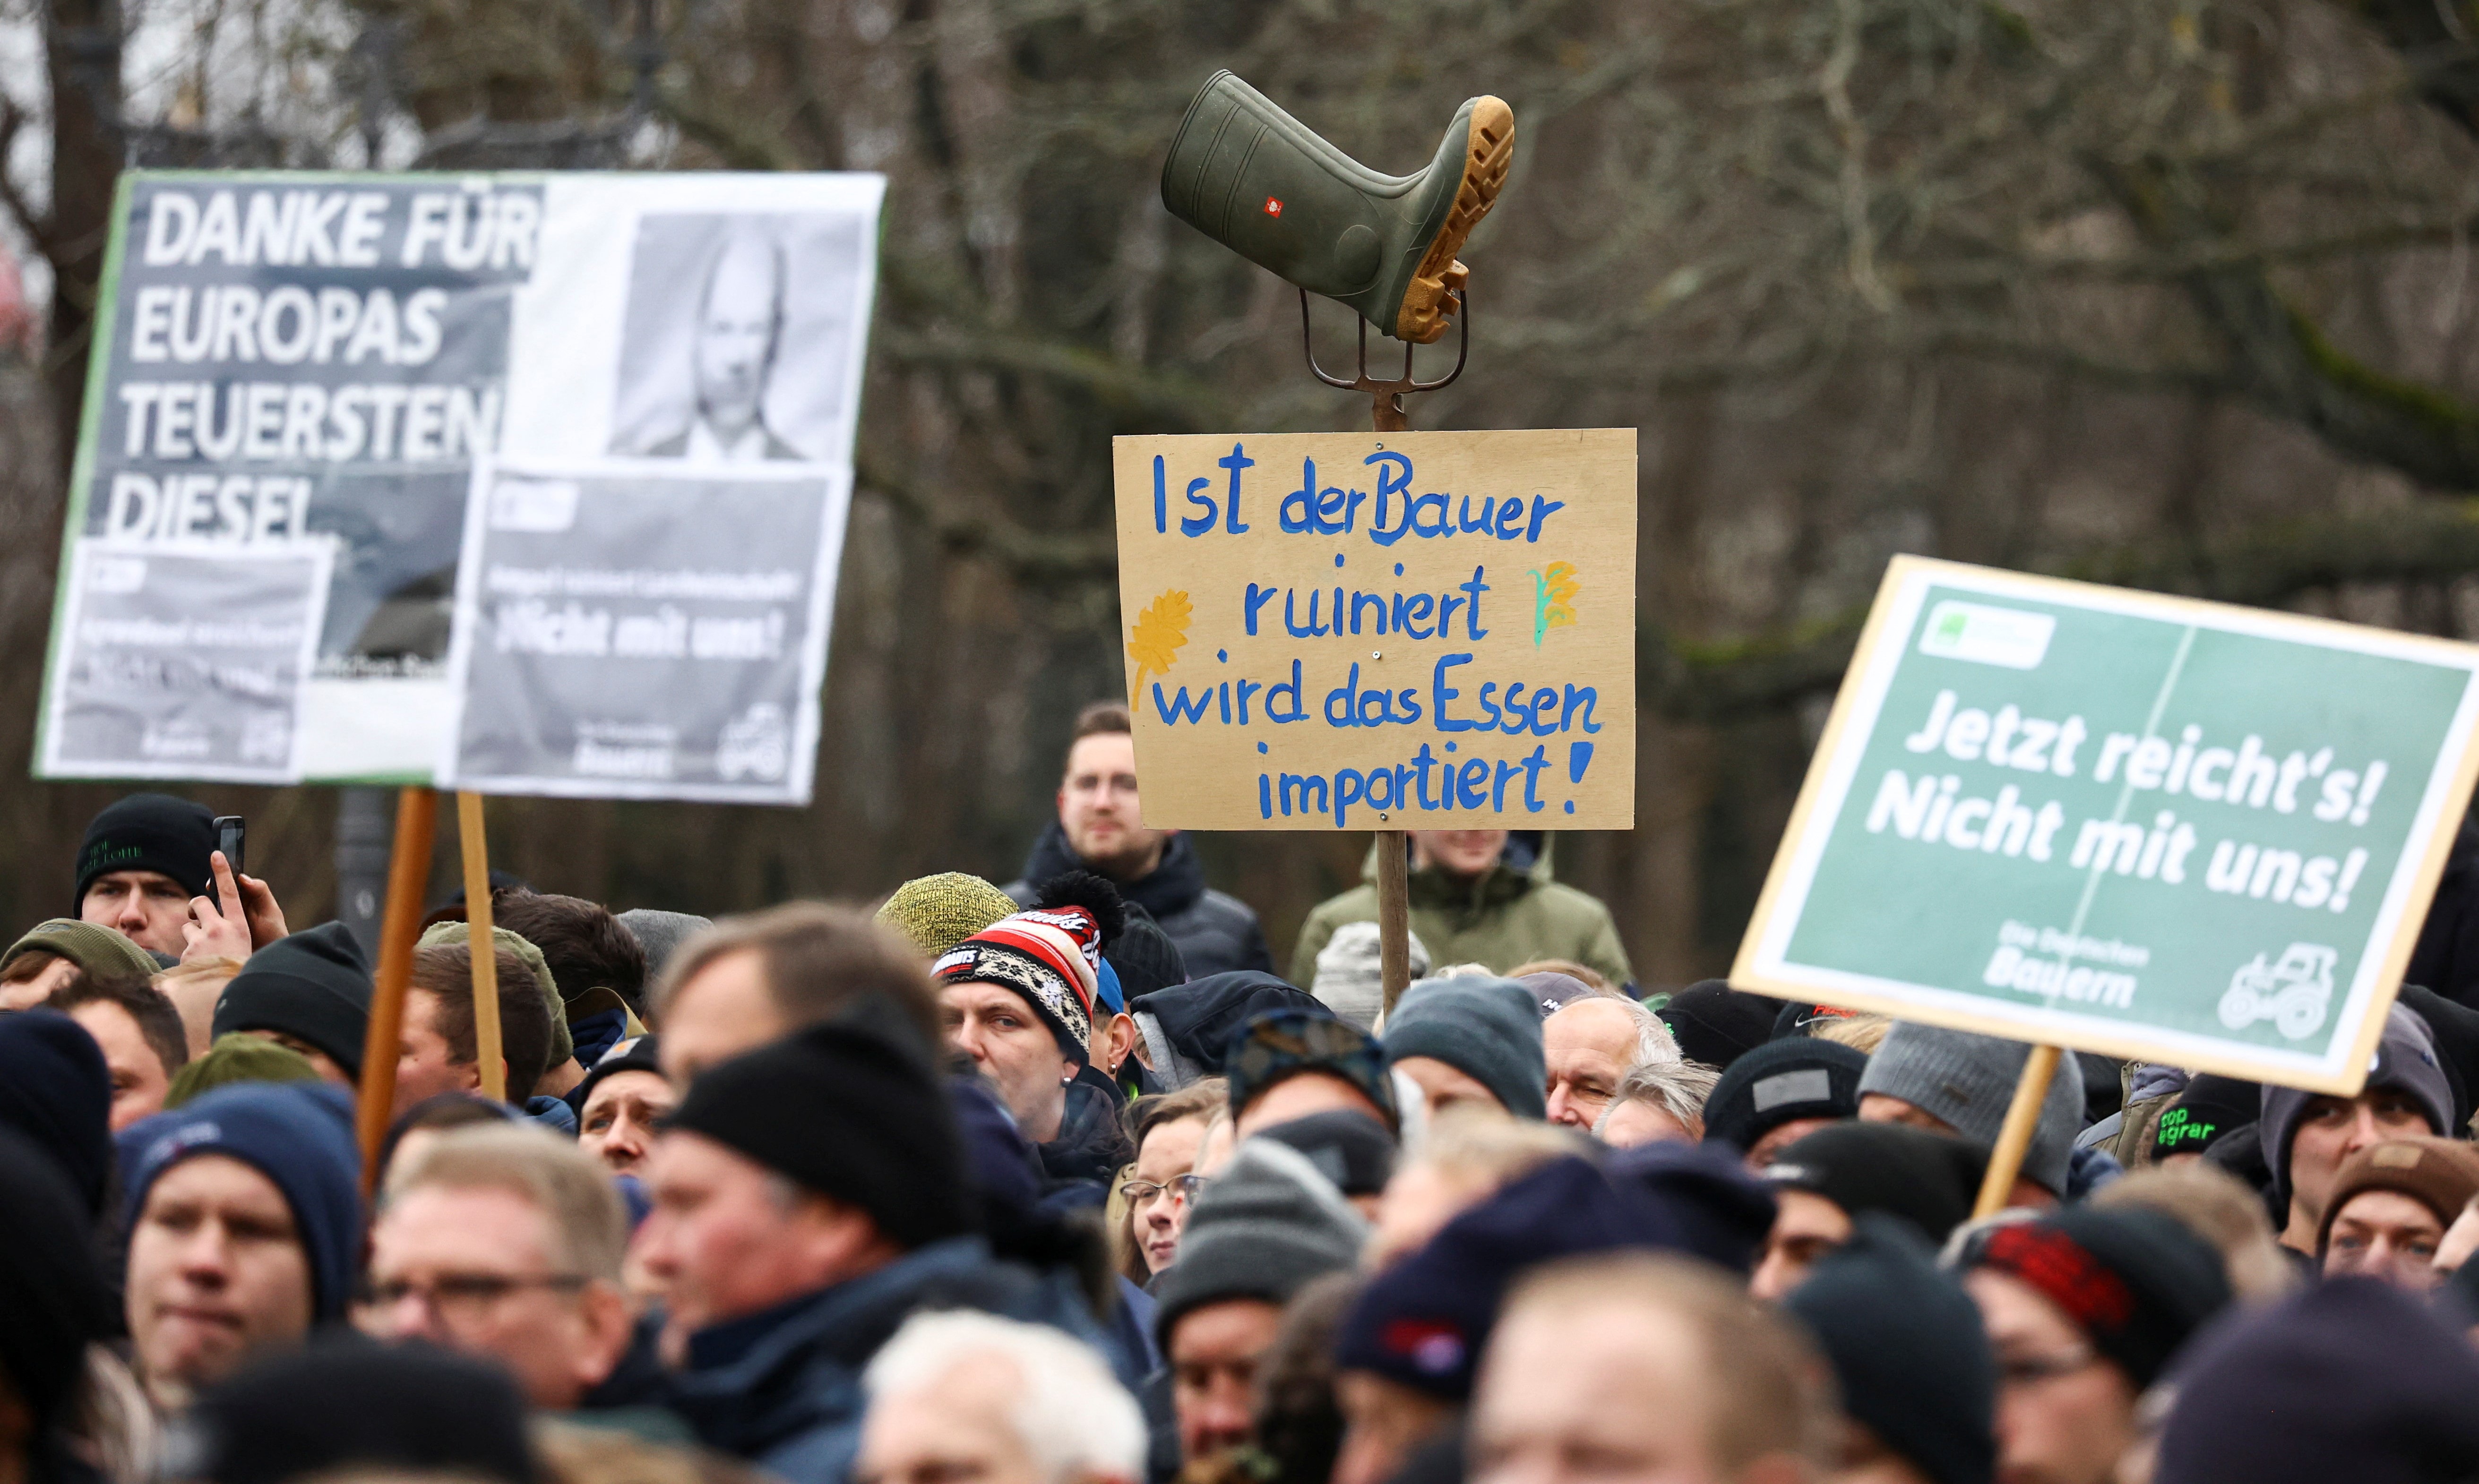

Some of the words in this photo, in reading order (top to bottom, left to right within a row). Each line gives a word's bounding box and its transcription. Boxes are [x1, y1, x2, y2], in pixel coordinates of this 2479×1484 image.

[144, 190, 390, 266] DANKE
[401, 179, 539, 269] FÜR
[129, 285, 448, 365] EUROPAS
[119, 383, 499, 461] TEUERSTEN
[106, 472, 319, 540] DIESEL
[1153, 443, 1255, 538] Ist
[1279, 456, 1366, 535] der
[1364, 451, 1565, 547] Bauer
[1244, 553, 1490, 641] ruiniert
[1152, 649, 1310, 726] wird
[1324, 662, 1422, 728] das
[1433, 652, 1602, 737] Essen
[1905, 688, 2087, 777] Jetzt
[1866, 769, 2064, 862] Nicht
[2070, 809, 2196, 884] mit
[2205, 838, 2369, 914] uns!
[1983, 943, 2136, 1009] Bauern
